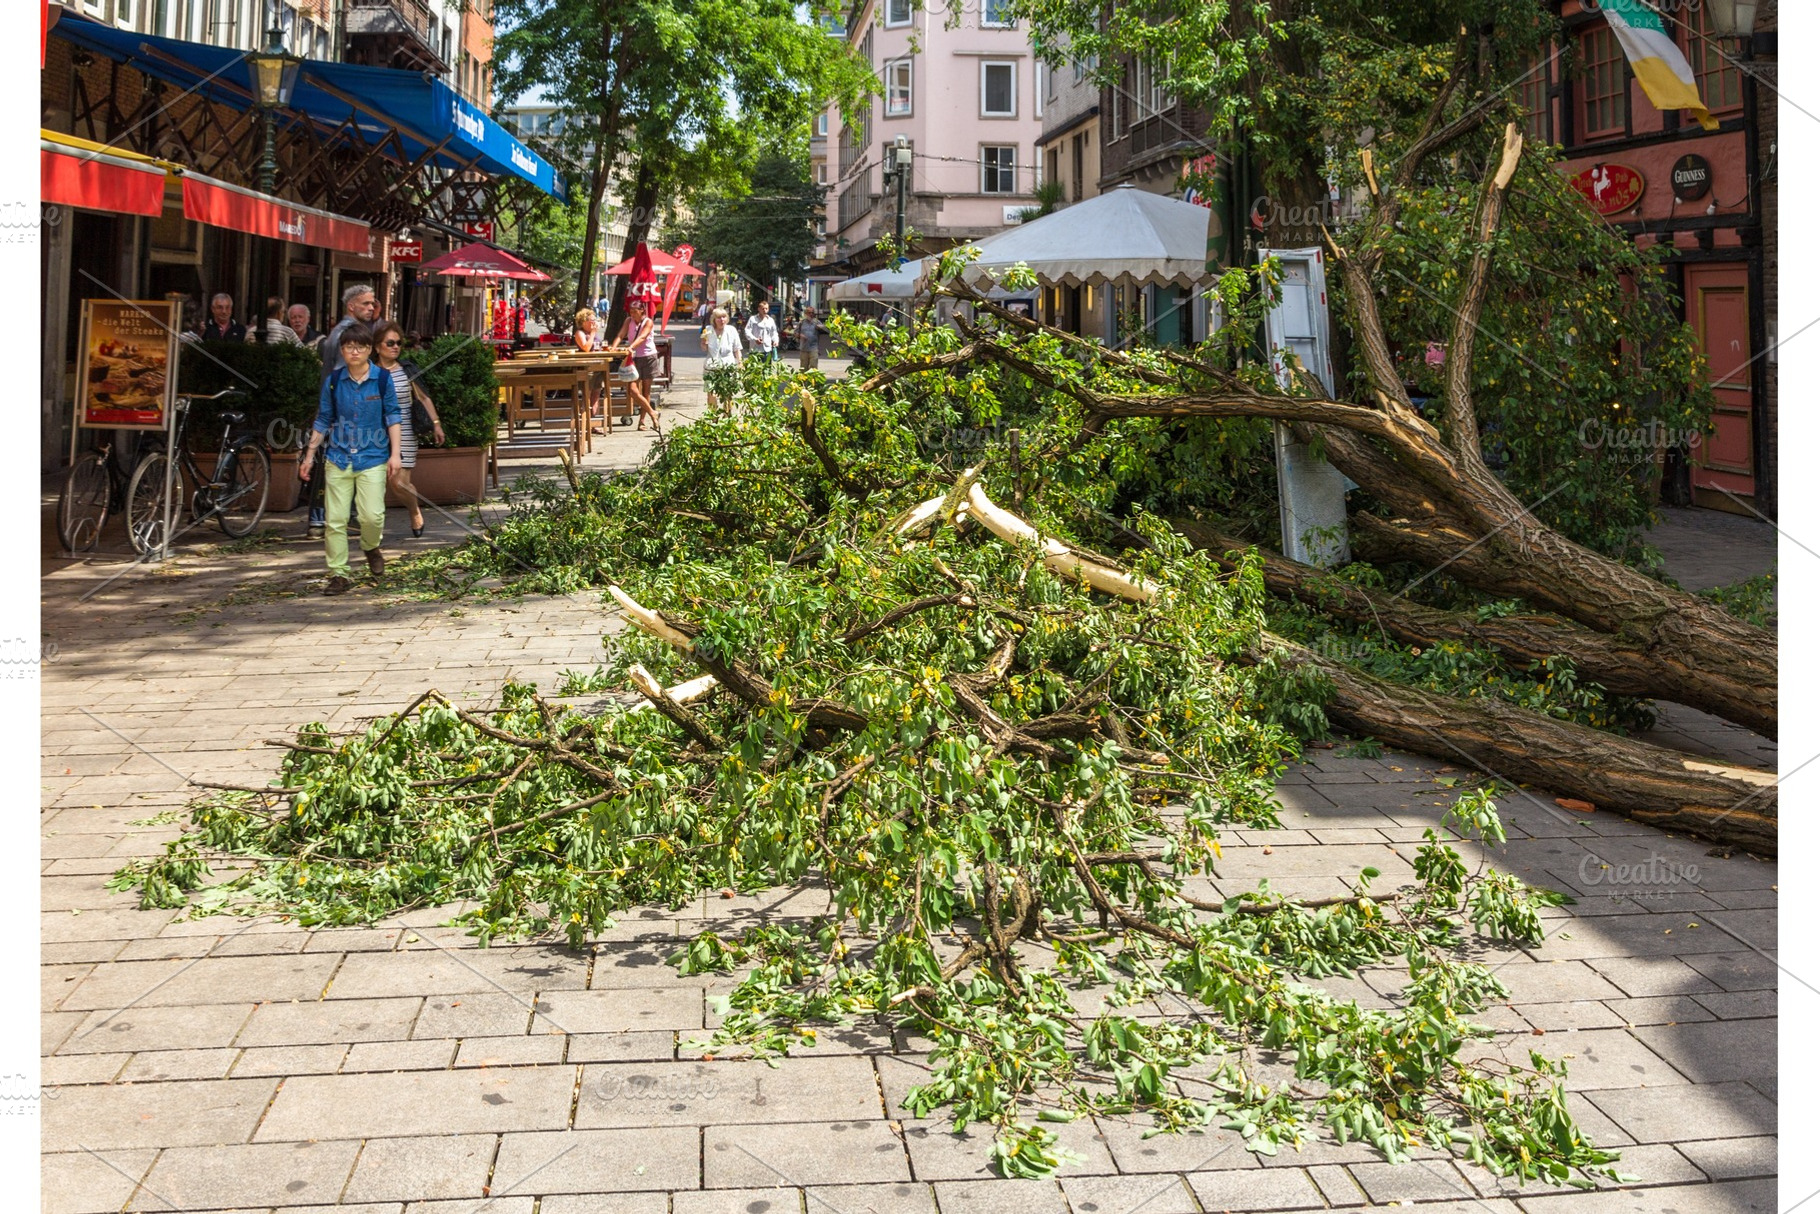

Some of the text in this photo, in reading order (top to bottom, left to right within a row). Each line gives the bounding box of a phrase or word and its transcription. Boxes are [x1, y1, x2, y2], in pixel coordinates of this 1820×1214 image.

[1674, 168, 1706, 183] GUINNESS
[391, 246, 420, 257] KFC
[454, 260, 501, 270] KFC
[627, 281, 662, 297] KFC
[120, 318, 141, 326] Welt
[133, 327, 165, 336] Steaks
